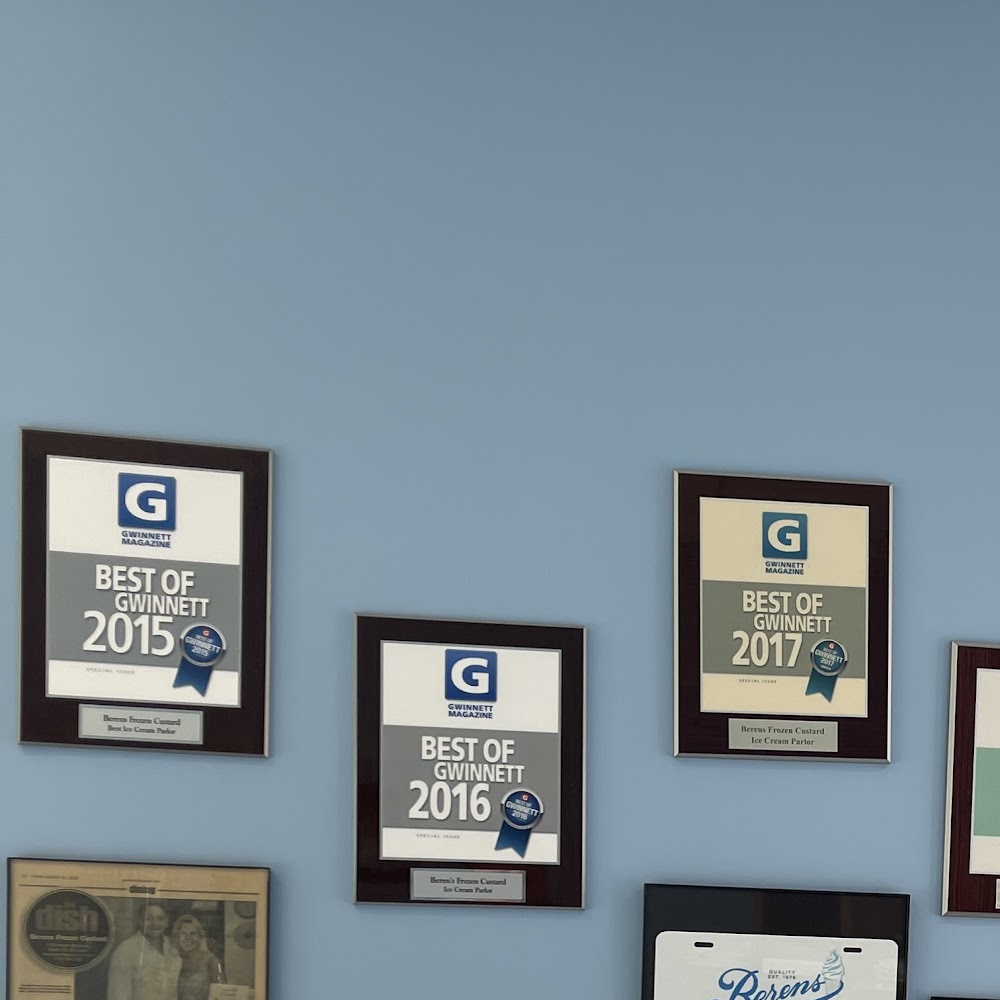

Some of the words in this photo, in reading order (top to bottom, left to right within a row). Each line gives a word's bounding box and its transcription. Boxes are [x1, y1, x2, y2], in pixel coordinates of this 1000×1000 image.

[125, 482, 166, 522] G
[121, 531, 171, 540] GWINNETT
[121, 538, 171, 548] MAGAZINE
[768, 519, 800, 553] G
[96, 564, 156, 592] BEST
[161, 569, 194, 595] OF
[115, 592, 209, 617] GWINNETT
[743, 590, 791, 613] BEST
[796, 593, 822, 615] OF
[82, 610, 174, 656] 2015
[754, 614, 831, 633] GWINNETT
[732, 630, 802, 668] 2017
[451, 658, 489, 693] G
[448, 704, 493, 712] GWINNETT
[448, 711, 493, 719] MAGAZINE
[422, 736, 478, 761] BEST
[483, 739, 514, 763] OF
[434, 762, 524, 783] GWINNETT
[409, 780, 490, 821] 2016
[512, 811, 528, 820] 2016
